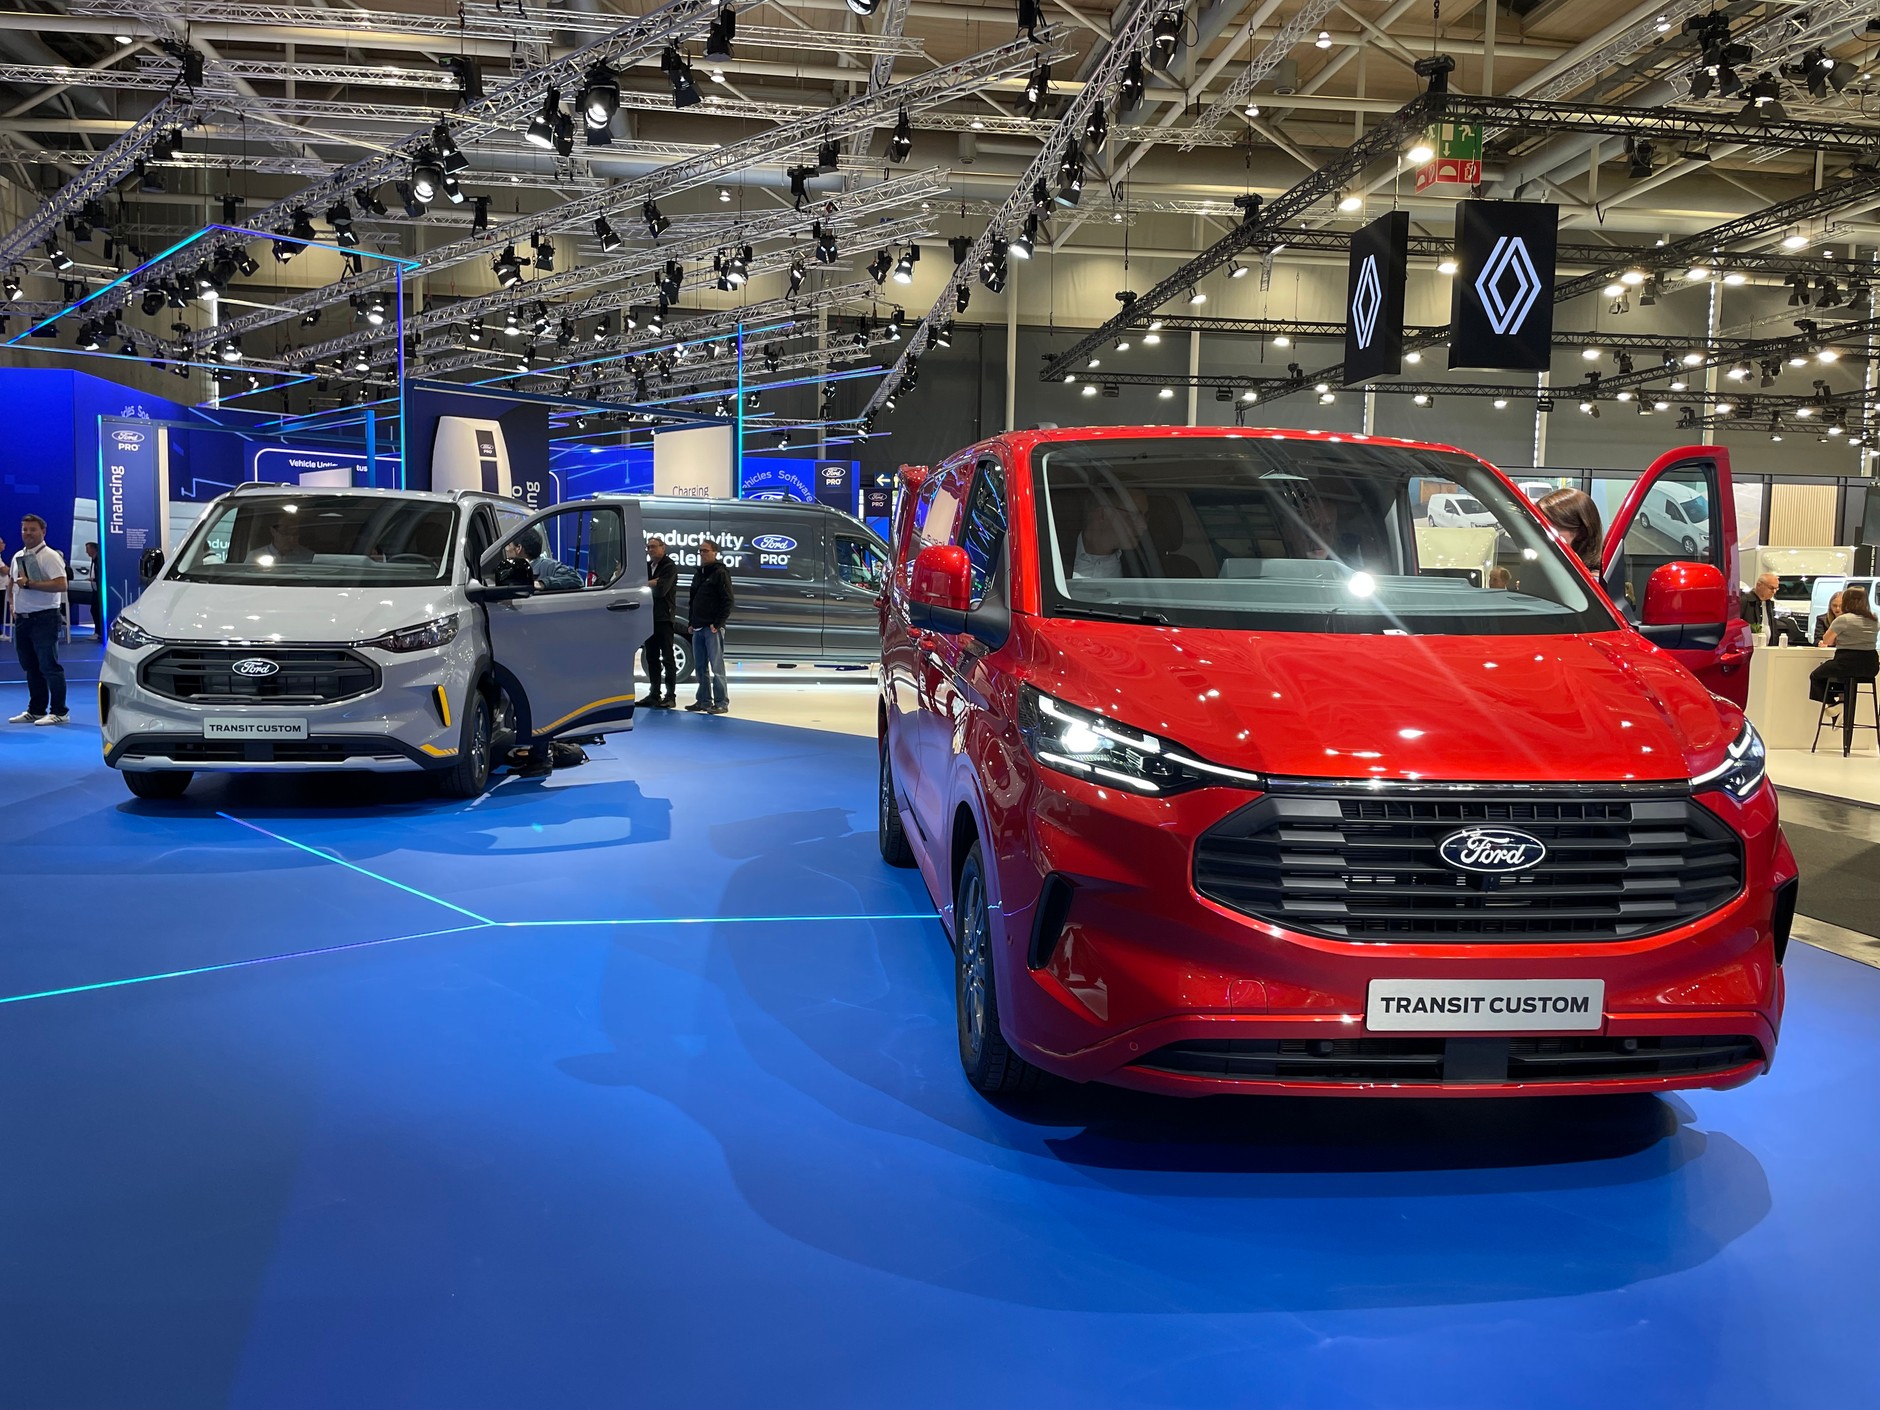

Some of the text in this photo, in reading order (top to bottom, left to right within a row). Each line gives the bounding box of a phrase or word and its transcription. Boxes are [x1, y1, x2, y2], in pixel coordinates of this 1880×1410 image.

[118, 443, 139, 451] PRO
[289, 459, 317, 469] Vehicle
[742, 470, 814, 503] ehicles Software
[825, 478, 842, 486] PRO
[672, 484, 710, 497] Charging
[109, 465, 125, 534] Financing
[760, 553, 789, 566] PRO
[209, 724, 302, 733] TRANSIT CUSTOM
[1380, 995, 1590, 1014] TRANSIT CUSTOM
